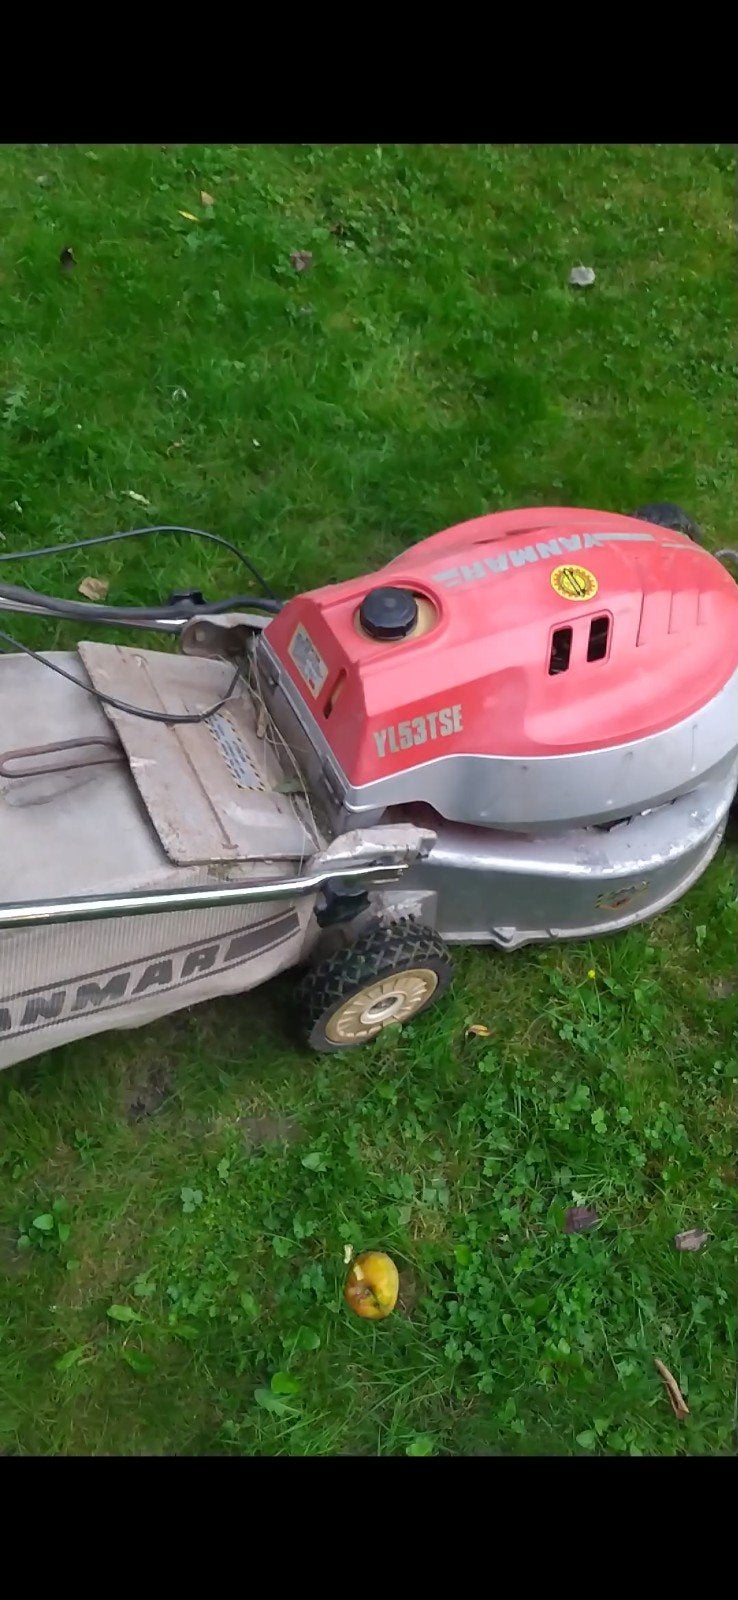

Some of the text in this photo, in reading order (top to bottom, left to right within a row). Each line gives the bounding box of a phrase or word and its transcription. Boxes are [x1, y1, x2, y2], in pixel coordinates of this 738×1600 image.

[462, 533, 603, 582] YANMAR
[373, 704, 463, 757] YL53TSE
[0, 944, 221, 1031] NMAR
